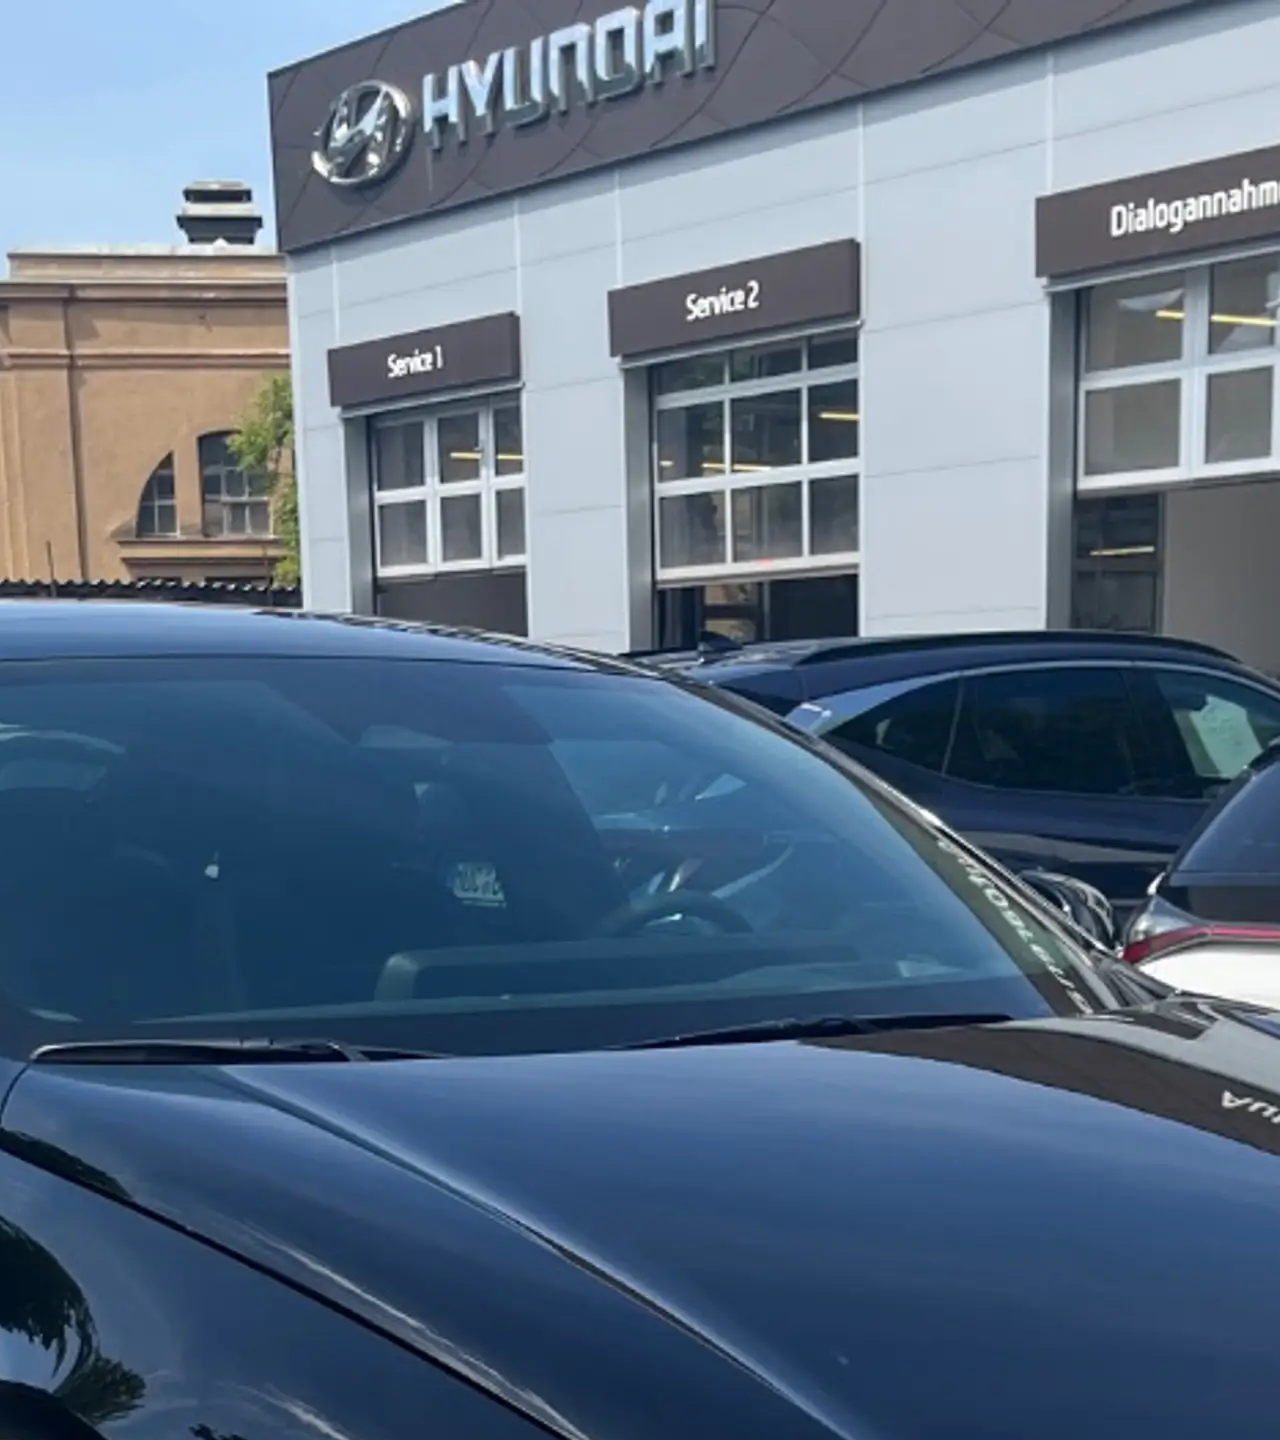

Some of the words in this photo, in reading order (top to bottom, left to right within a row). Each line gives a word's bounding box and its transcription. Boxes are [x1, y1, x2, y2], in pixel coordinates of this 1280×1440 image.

[422, 0, 716, 150] HYUNDAI
[685, 285, 745, 321] Service
[747, 279, 760, 309] 2
[387, 348, 433, 378] Service
[434, 344, 444, 370] 1
